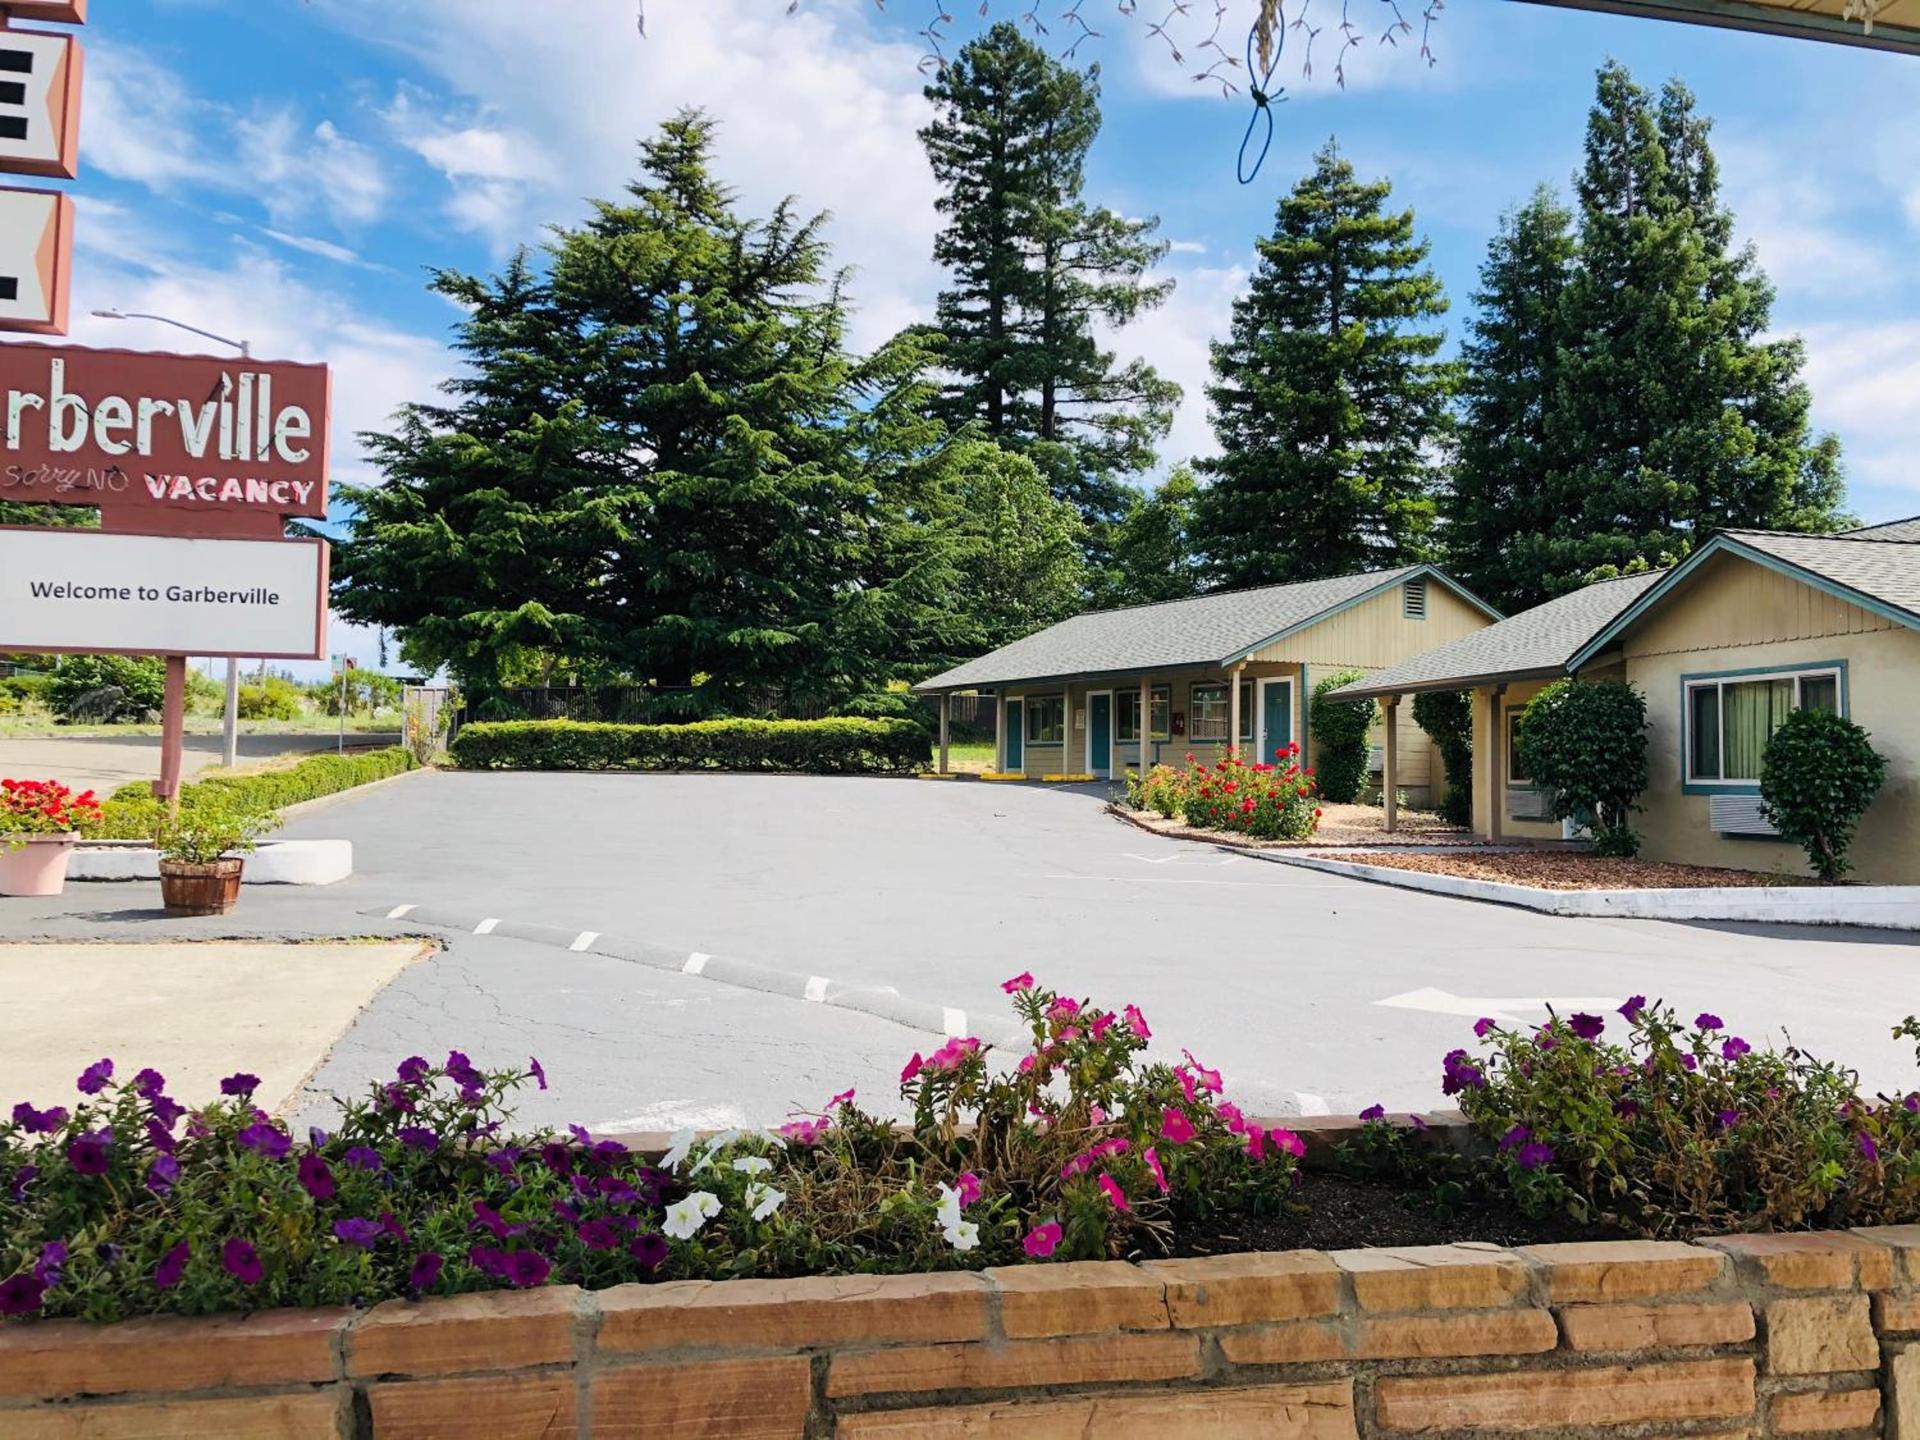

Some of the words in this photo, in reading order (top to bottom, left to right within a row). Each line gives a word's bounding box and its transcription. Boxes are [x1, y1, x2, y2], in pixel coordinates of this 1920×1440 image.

[86, 467, 129, 492] NO
[143, 473, 314, 505] VACANCY
[30, 581, 131, 601] Welcome
[138, 586, 160, 602] to
[166, 585, 280, 606] Garberville
